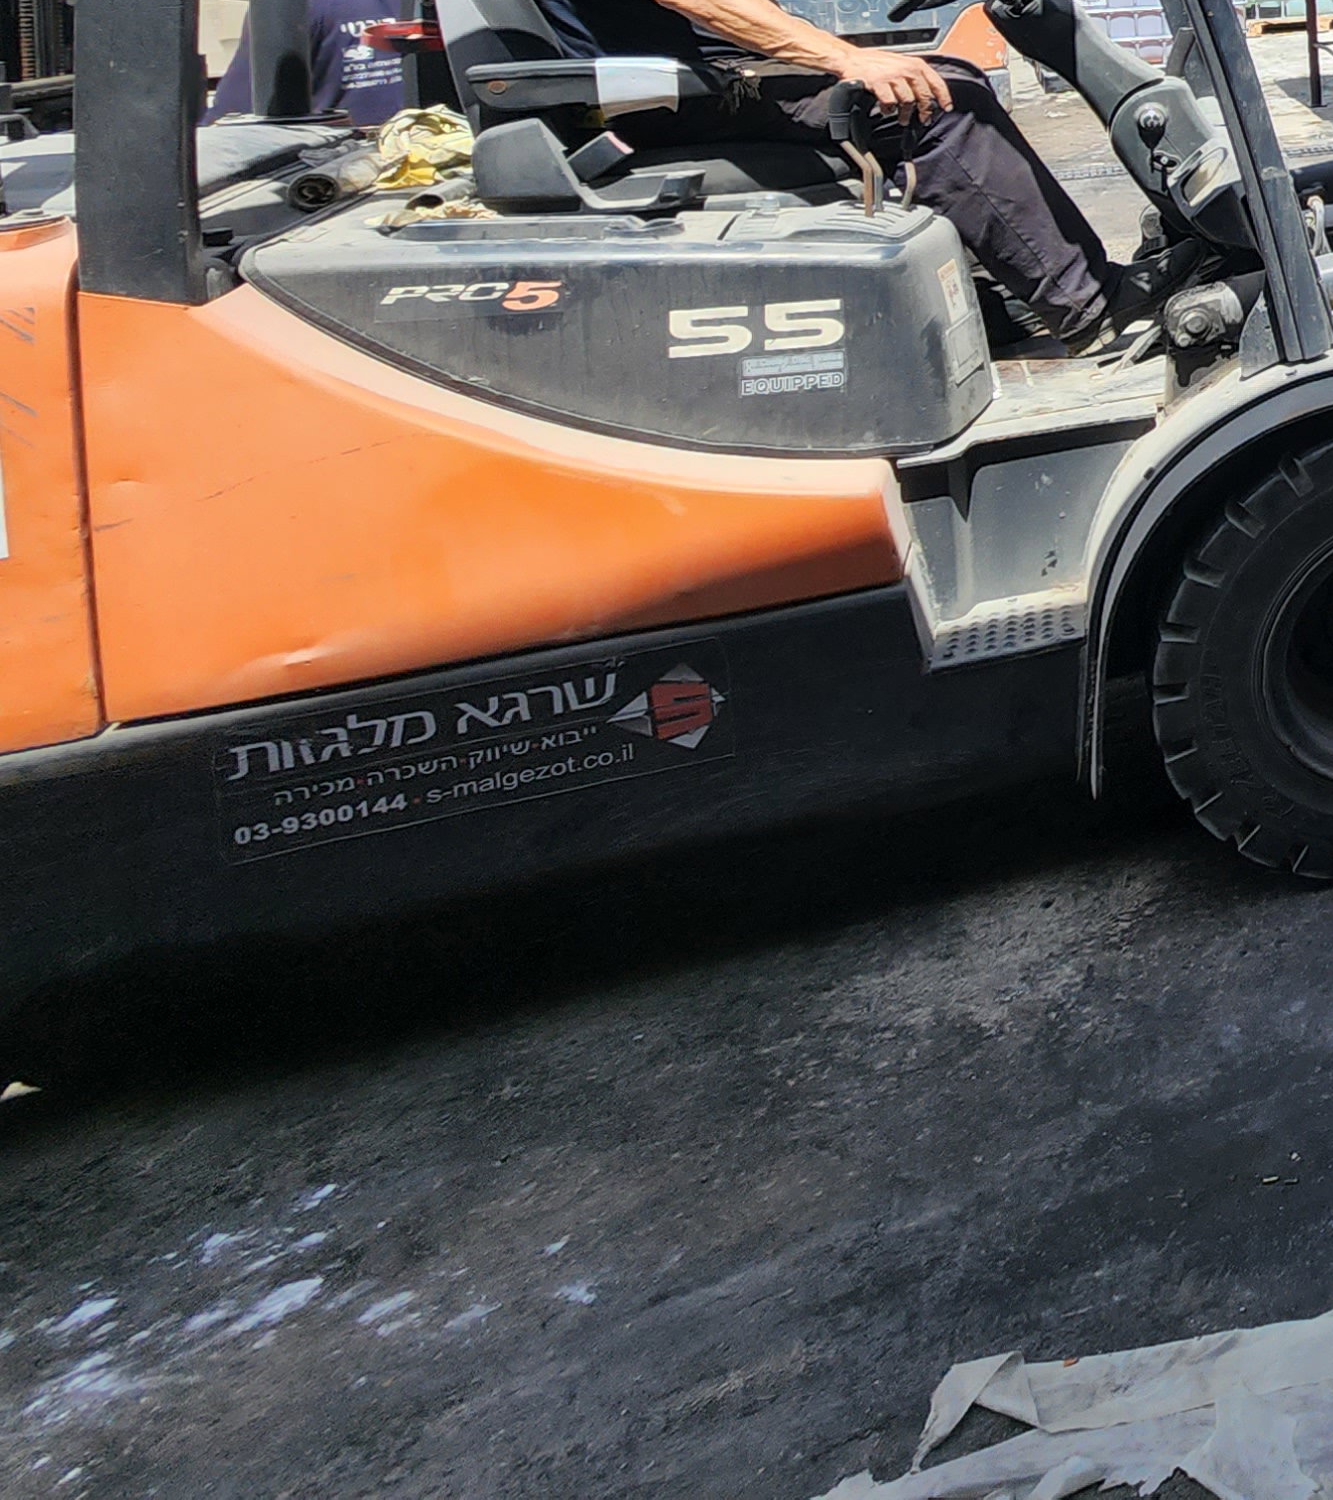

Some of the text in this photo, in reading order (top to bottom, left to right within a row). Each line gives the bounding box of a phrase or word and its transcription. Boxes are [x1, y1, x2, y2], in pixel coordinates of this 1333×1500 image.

[668, 299, 845, 358] 55
[741, 371, 844, 396] EQUIPPED
[228, 672, 617, 781] שרגא מלגזות
[273, 725, 597, 807] ייבוא שיווק השכרה מכירה
[234, 743, 634, 846] 03-9300144 s-malgezot.co.il
